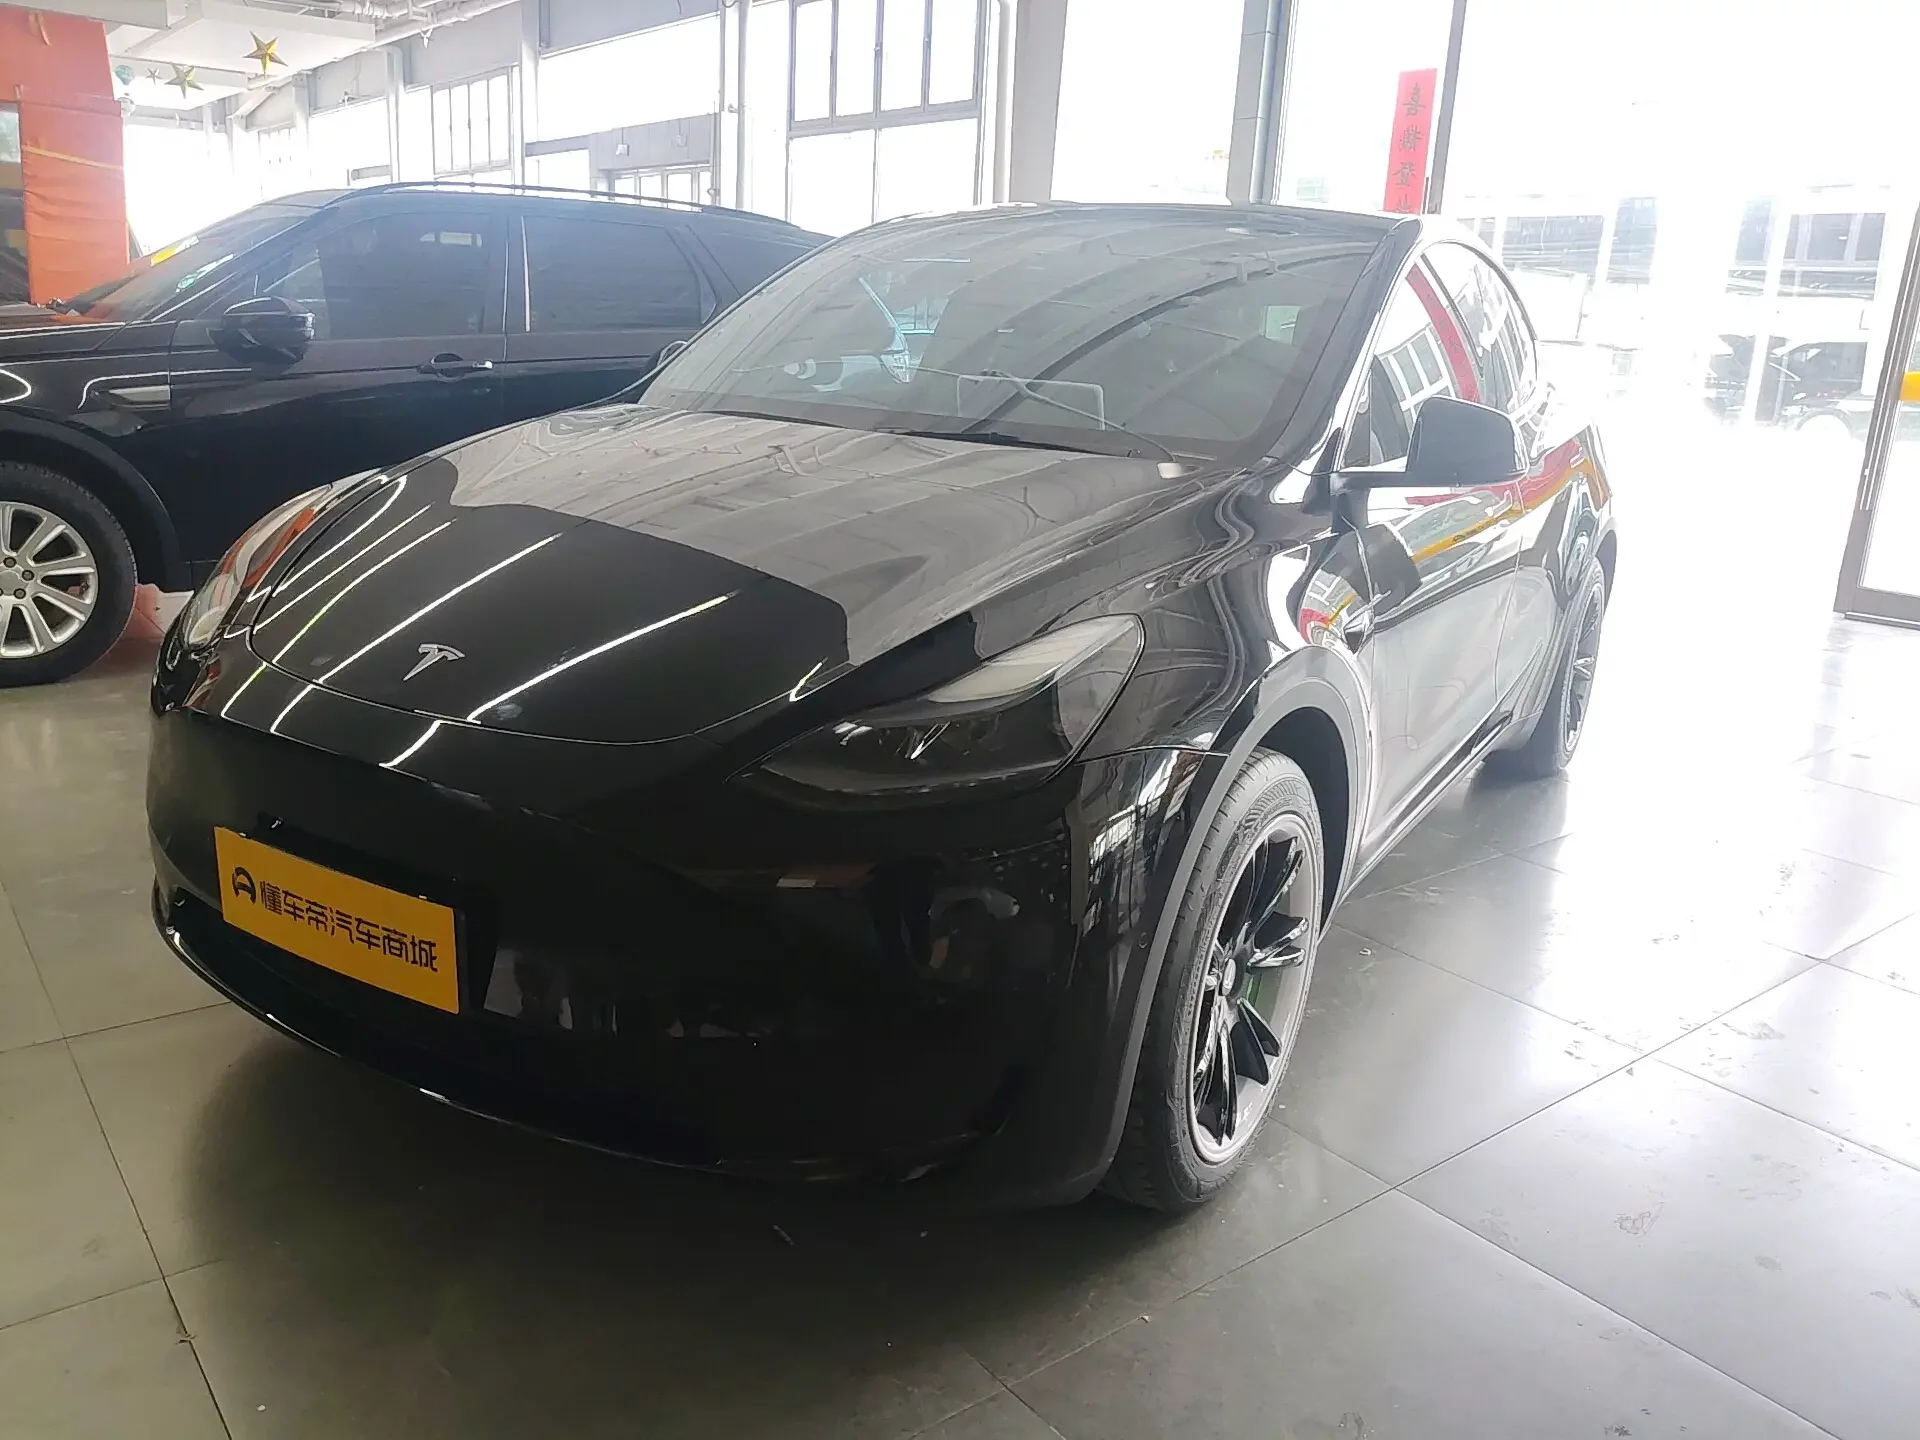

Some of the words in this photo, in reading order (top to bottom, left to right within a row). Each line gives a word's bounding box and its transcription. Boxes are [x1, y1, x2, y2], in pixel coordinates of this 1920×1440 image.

[260, 880, 438, 973] 懂车帝汽车商城
